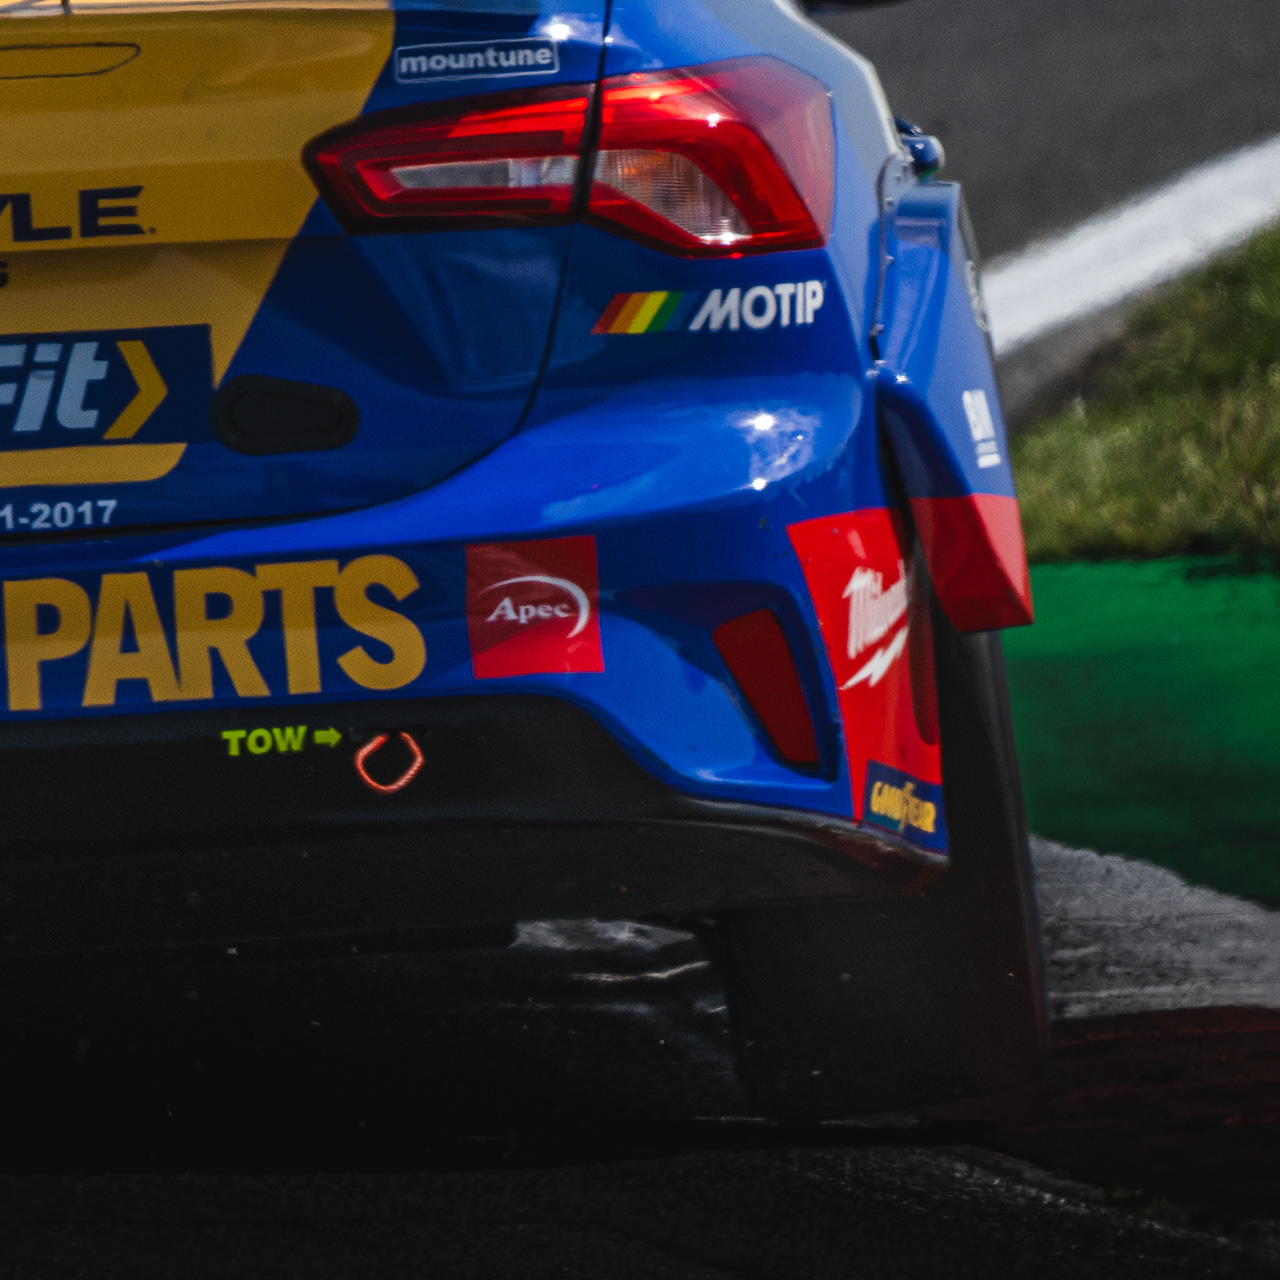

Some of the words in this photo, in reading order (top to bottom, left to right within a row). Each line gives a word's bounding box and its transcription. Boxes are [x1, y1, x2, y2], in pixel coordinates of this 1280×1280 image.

[399, 44, 553, 75] mountune
[688, 279, 824, 334] MOTIP
[485, 595, 572, 623] Apec
[1, 553, 427, 712] PARTS
[221, 725, 308, 756] TOW
